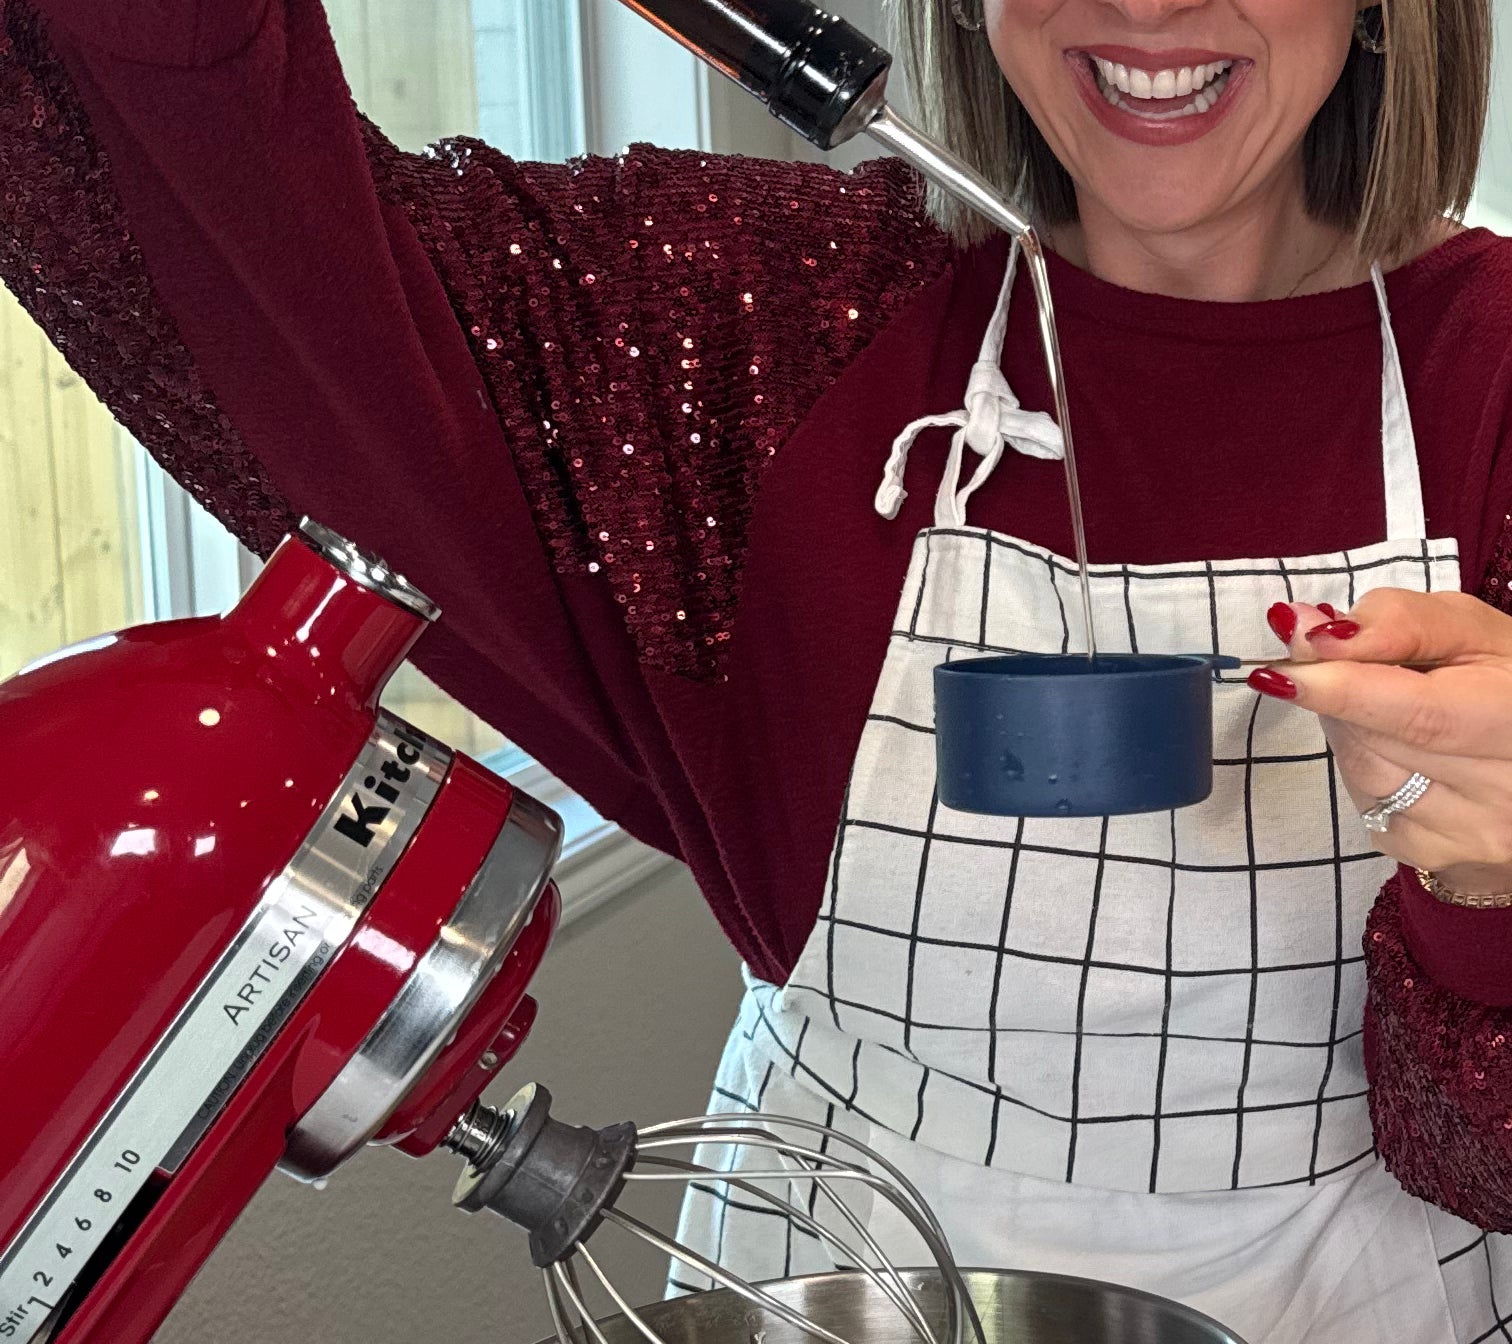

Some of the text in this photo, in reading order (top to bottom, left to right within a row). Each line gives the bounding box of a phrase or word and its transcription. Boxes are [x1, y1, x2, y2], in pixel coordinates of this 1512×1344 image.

[362, 866, 384, 896] parts
[223, 905, 318, 1026] ARTISAN
[0, 1149, 140, 1336] Stir 2 4 6 8 10
